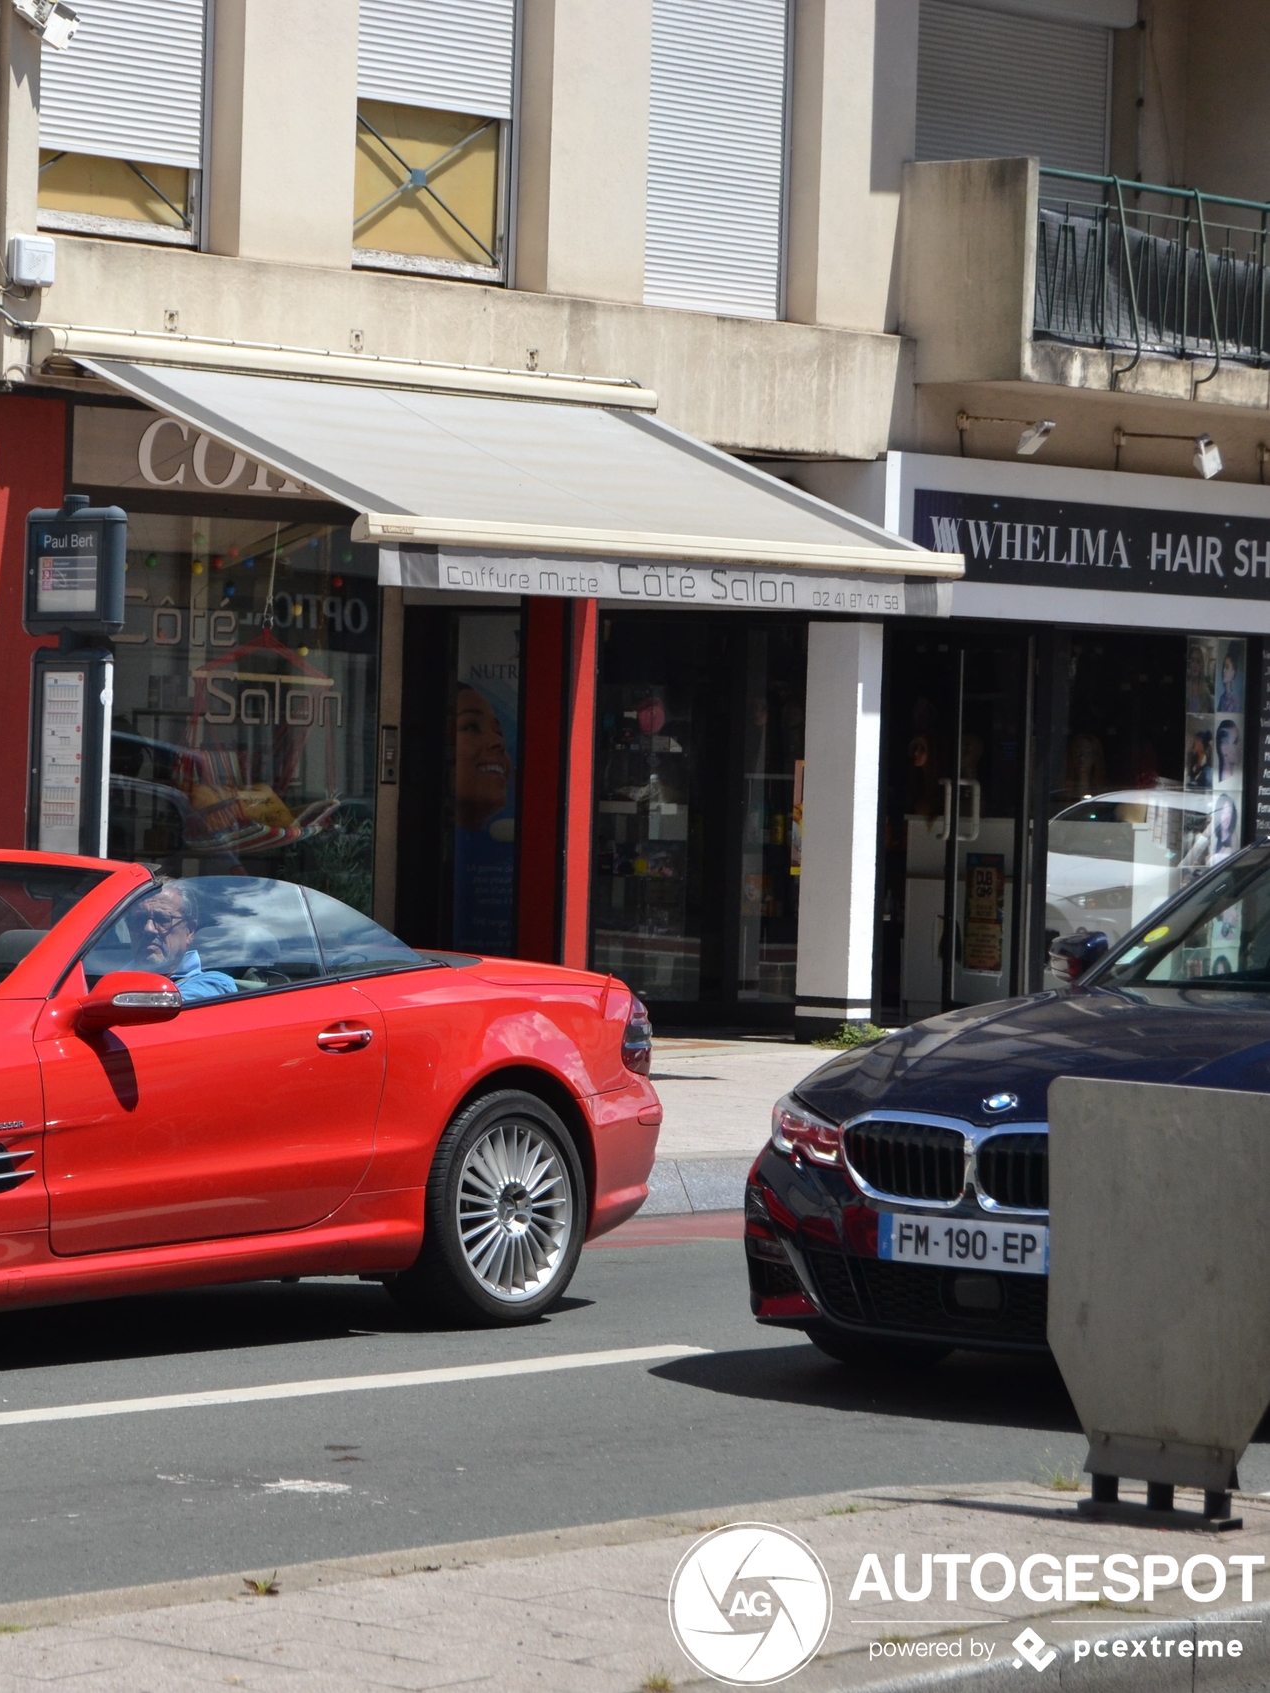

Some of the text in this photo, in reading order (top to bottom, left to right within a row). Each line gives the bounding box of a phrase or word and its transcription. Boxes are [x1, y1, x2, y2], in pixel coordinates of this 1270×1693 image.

[44, 534, 94, 549] Paul Bert
[966, 519, 1132, 568] WHELIMA
[1150, 532, 1224, 577] HAIR
[447, 566, 530, 590] Coiffure
[618, 563, 696, 599] Côté
[711, 569, 795, 604] Salon
[813, 591, 829, 607] 02
[834, 592, 845, 608] 41
[850, 593, 862, 609] 87
[867, 594, 879, 610] 47
[204, 670, 342, 727] Salon
